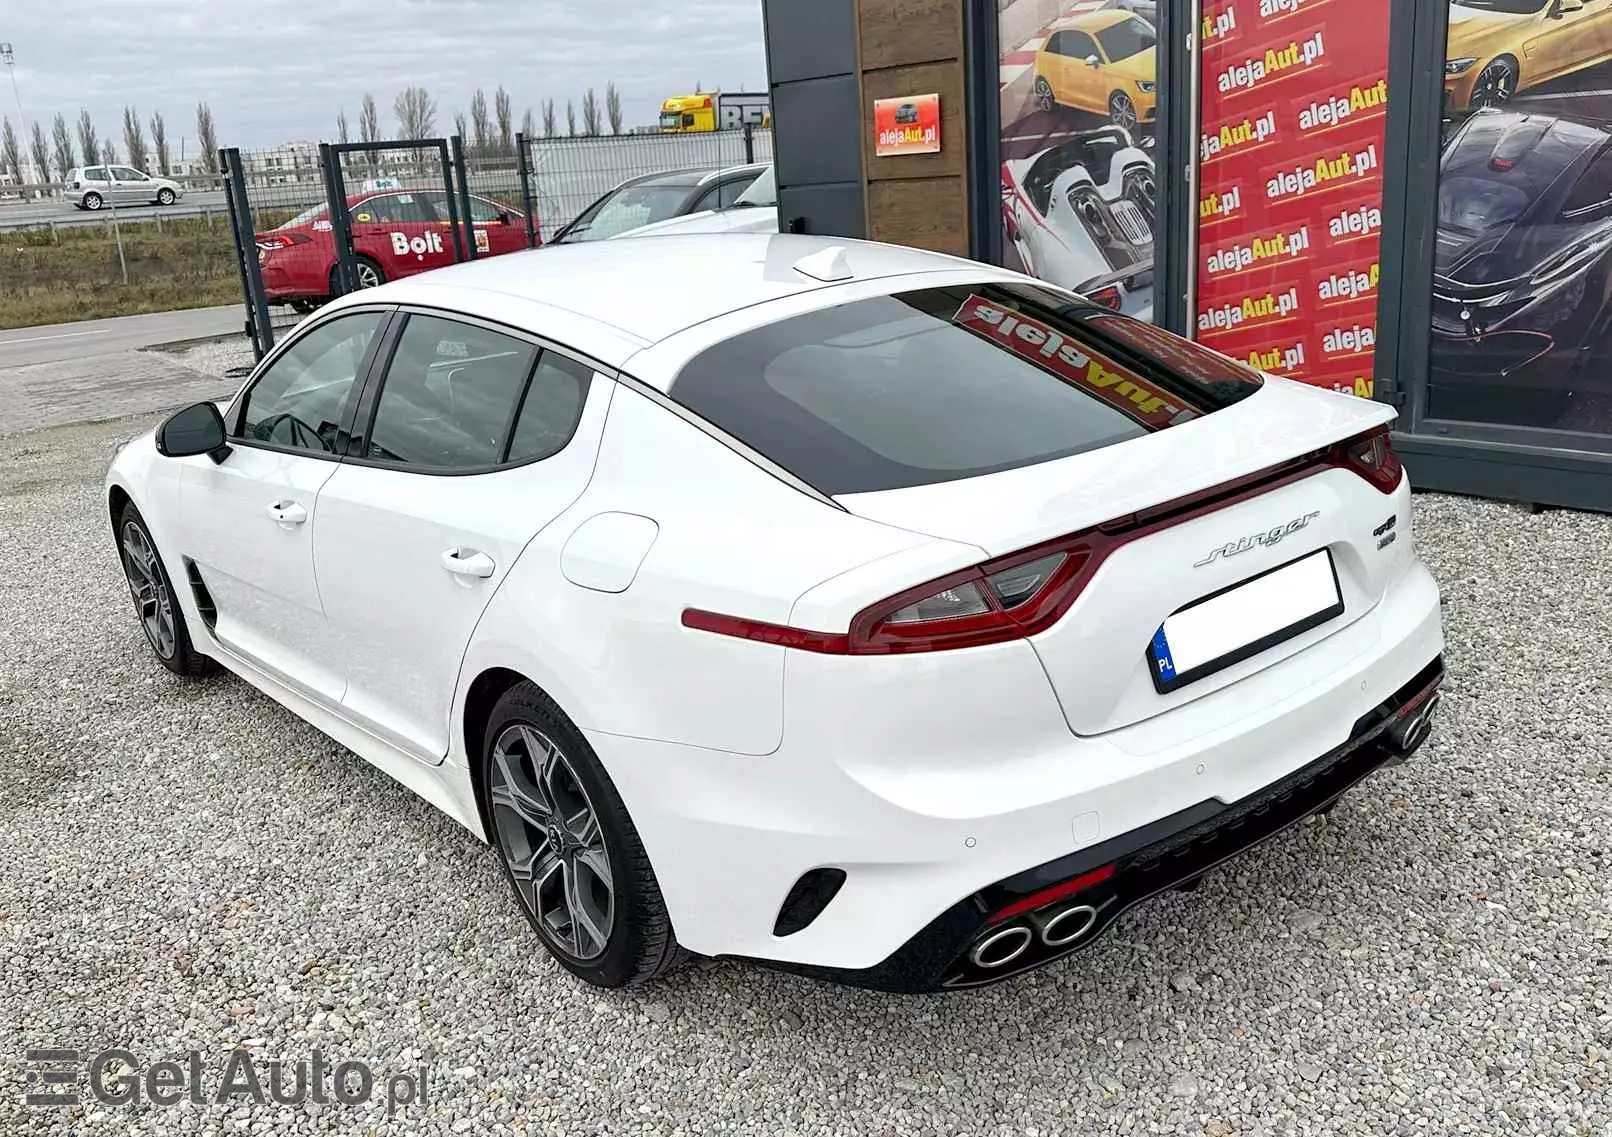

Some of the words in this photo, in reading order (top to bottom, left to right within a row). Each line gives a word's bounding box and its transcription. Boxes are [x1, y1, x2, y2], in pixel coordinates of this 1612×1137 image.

[1218, 31, 1324, 92] alejaAut.pl
[880, 125, 936, 147] alejaAut.pl
[1266, 145, 1377, 198] alejaAut.pl
[1329, 206, 1381, 236] aleja
[390, 230, 444, 261] Bolt
[1207, 227, 1309, 273] alejaAut.pl
[1198, 288, 1298, 330] alejaAut.pl
[1158, 657, 1172, 673] PL
